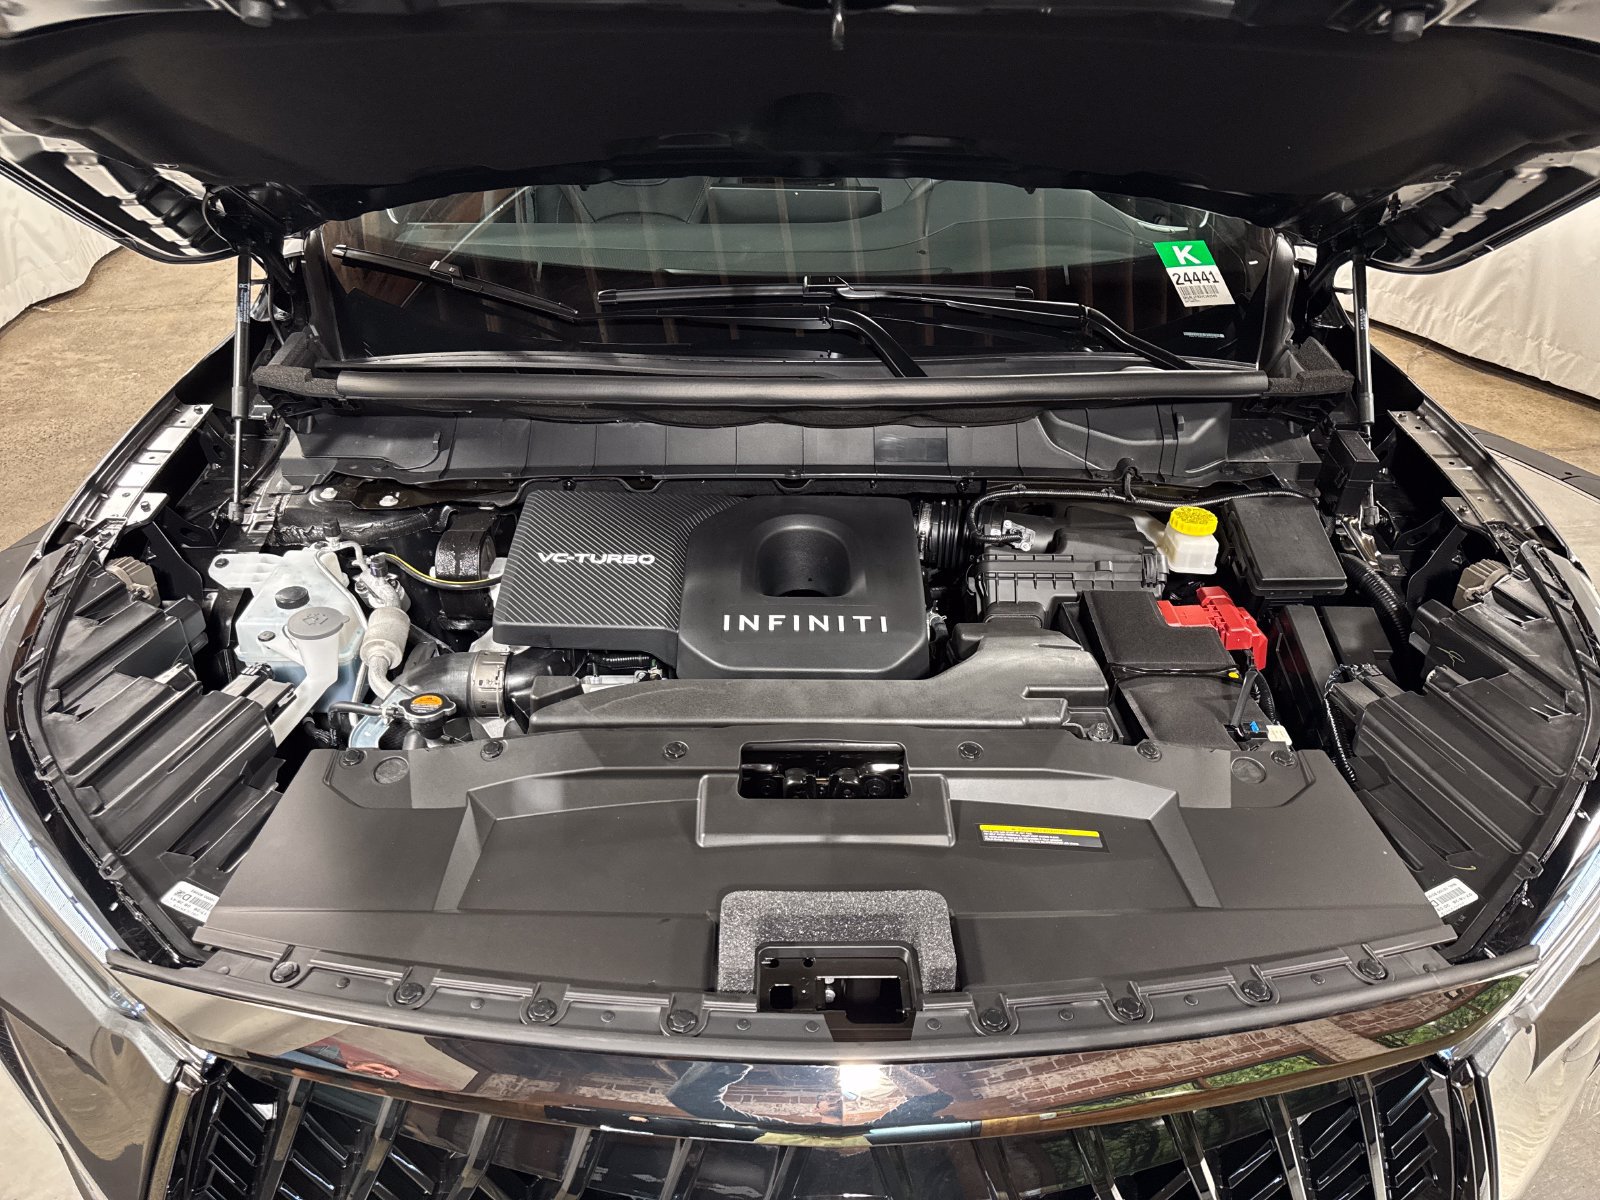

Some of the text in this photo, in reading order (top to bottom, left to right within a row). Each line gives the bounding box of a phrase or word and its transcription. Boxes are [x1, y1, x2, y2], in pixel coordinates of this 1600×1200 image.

[1172, 245, 1202, 265] K
[1172, 270, 1219, 286] 24441
[537, 552, 656, 565] VC-TURBO
[722, 614, 888, 633] INFINITI
